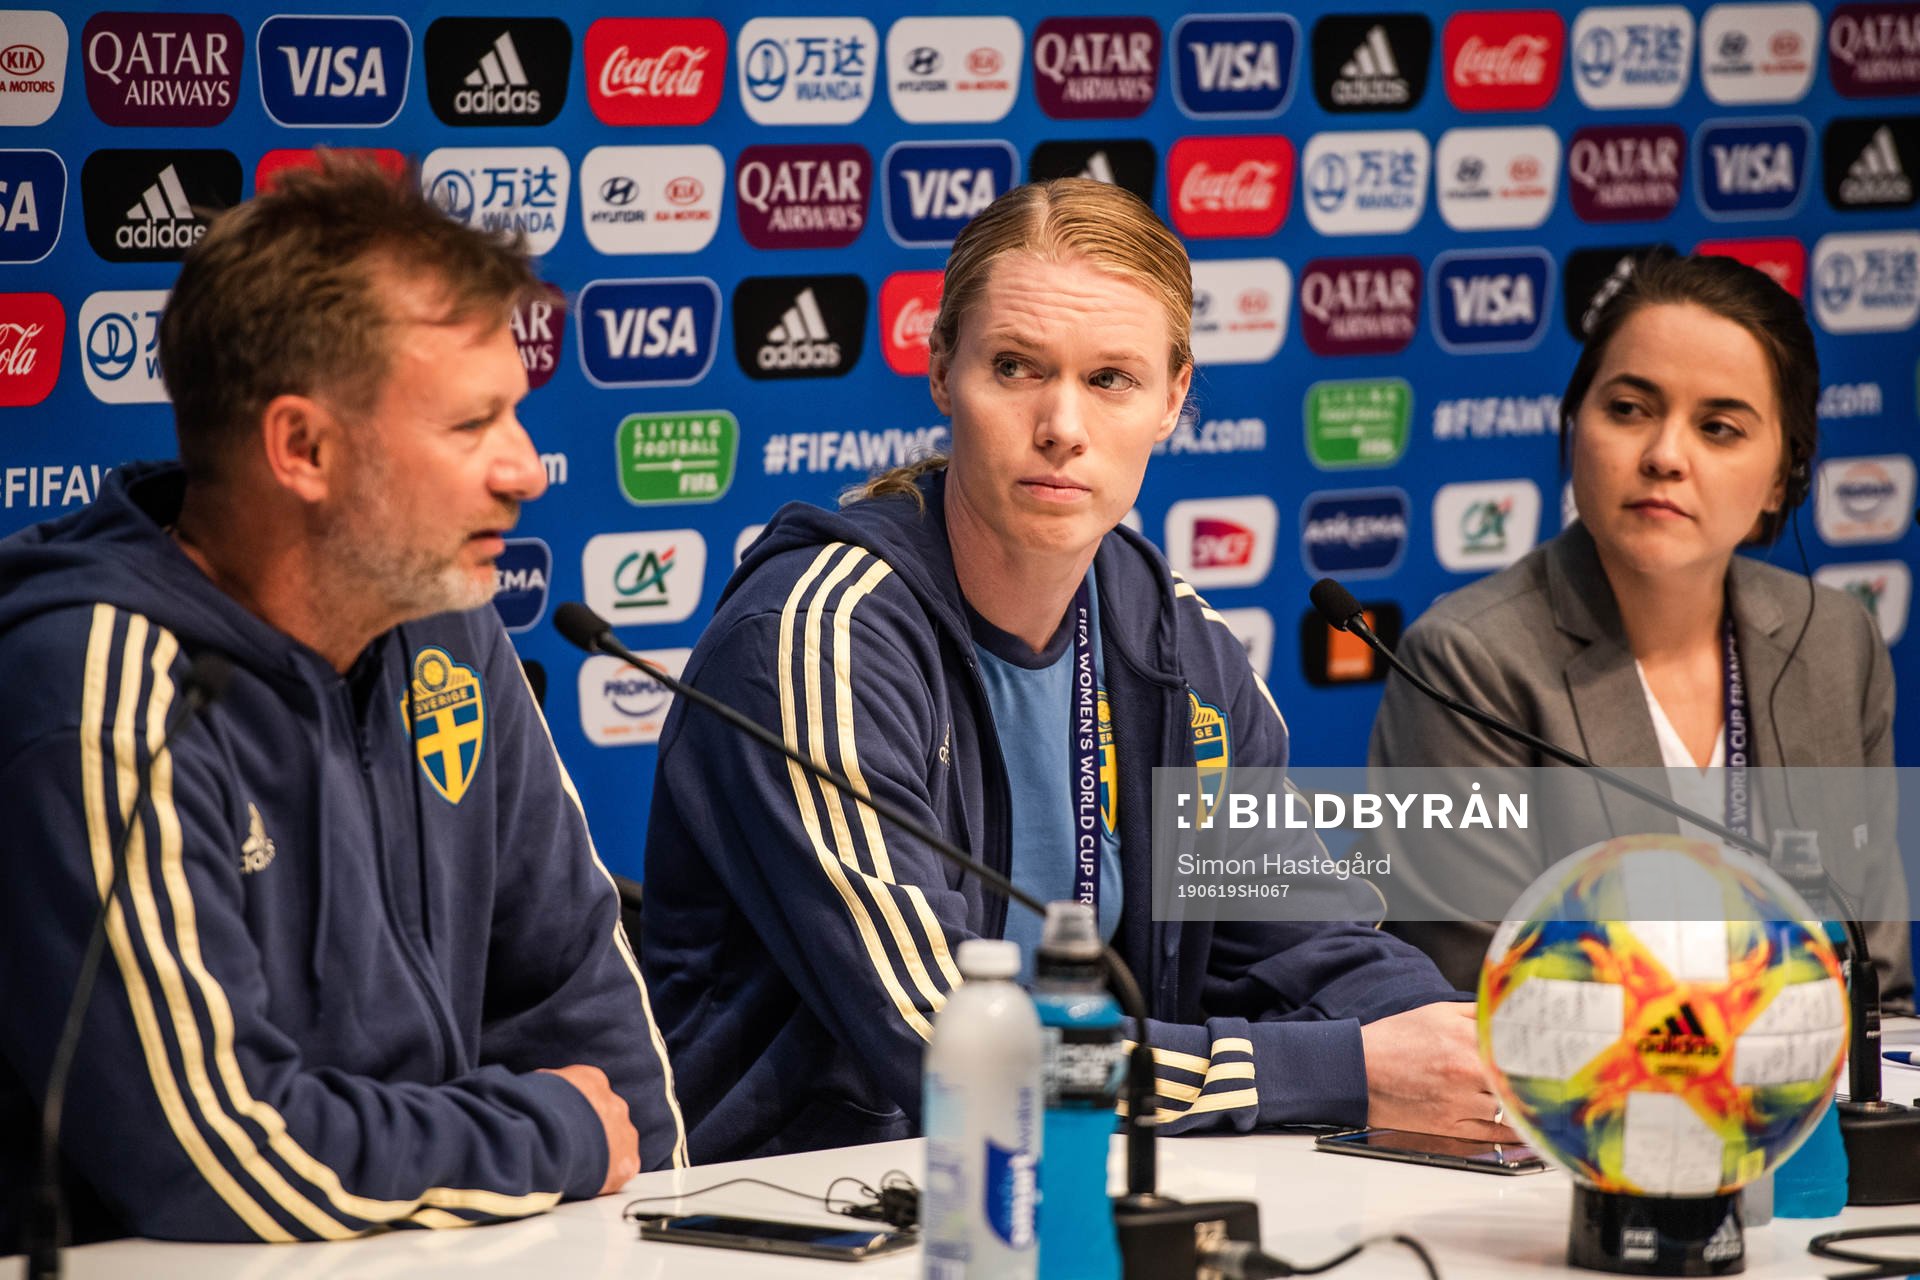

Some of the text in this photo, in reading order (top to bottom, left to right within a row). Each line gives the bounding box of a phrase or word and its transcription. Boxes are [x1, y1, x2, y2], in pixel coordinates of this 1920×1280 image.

[7, 51, 37, 69] KIA
[88, 31, 230, 85] QATAR
[277, 46, 388, 97] VISA
[795, 36, 866, 77] 万达
[1034, 32, 1153, 84] QATAR
[1188, 41, 1281, 92] VISA
[10, 80, 56, 93] MOTORS
[125, 79, 230, 107] AIRWAYS
[454, 84, 541, 114] adidas
[795, 80, 864, 102] WANDA
[1569, 136, 1679, 188] QATAR
[1711, 142, 1795, 194] VISA
[481, 166, 558, 208] 万达
[738, 160, 861, 213] QATAR
[900, 169, 996, 220] VISA
[481, 211, 557, 233] WANDA
[767, 204, 863, 233] AIRWAYS
[1301, 269, 1415, 324] QATAR
[1447, 272, 1536, 327] VISA
[595, 306, 698, 359] VISA
[757, 341, 841, 370] adidas
[633, 419, 722, 439] LIVING
[633, 439, 719, 459] FOOTBALL
[1078, 607, 1089, 648] FIFA
[1079, 652, 1094, 751] WOMEN'S
[1730, 708, 1747, 751] CUP
[1080, 755, 1095, 831] WORLD
[1080, 834, 1095, 877] CUP
